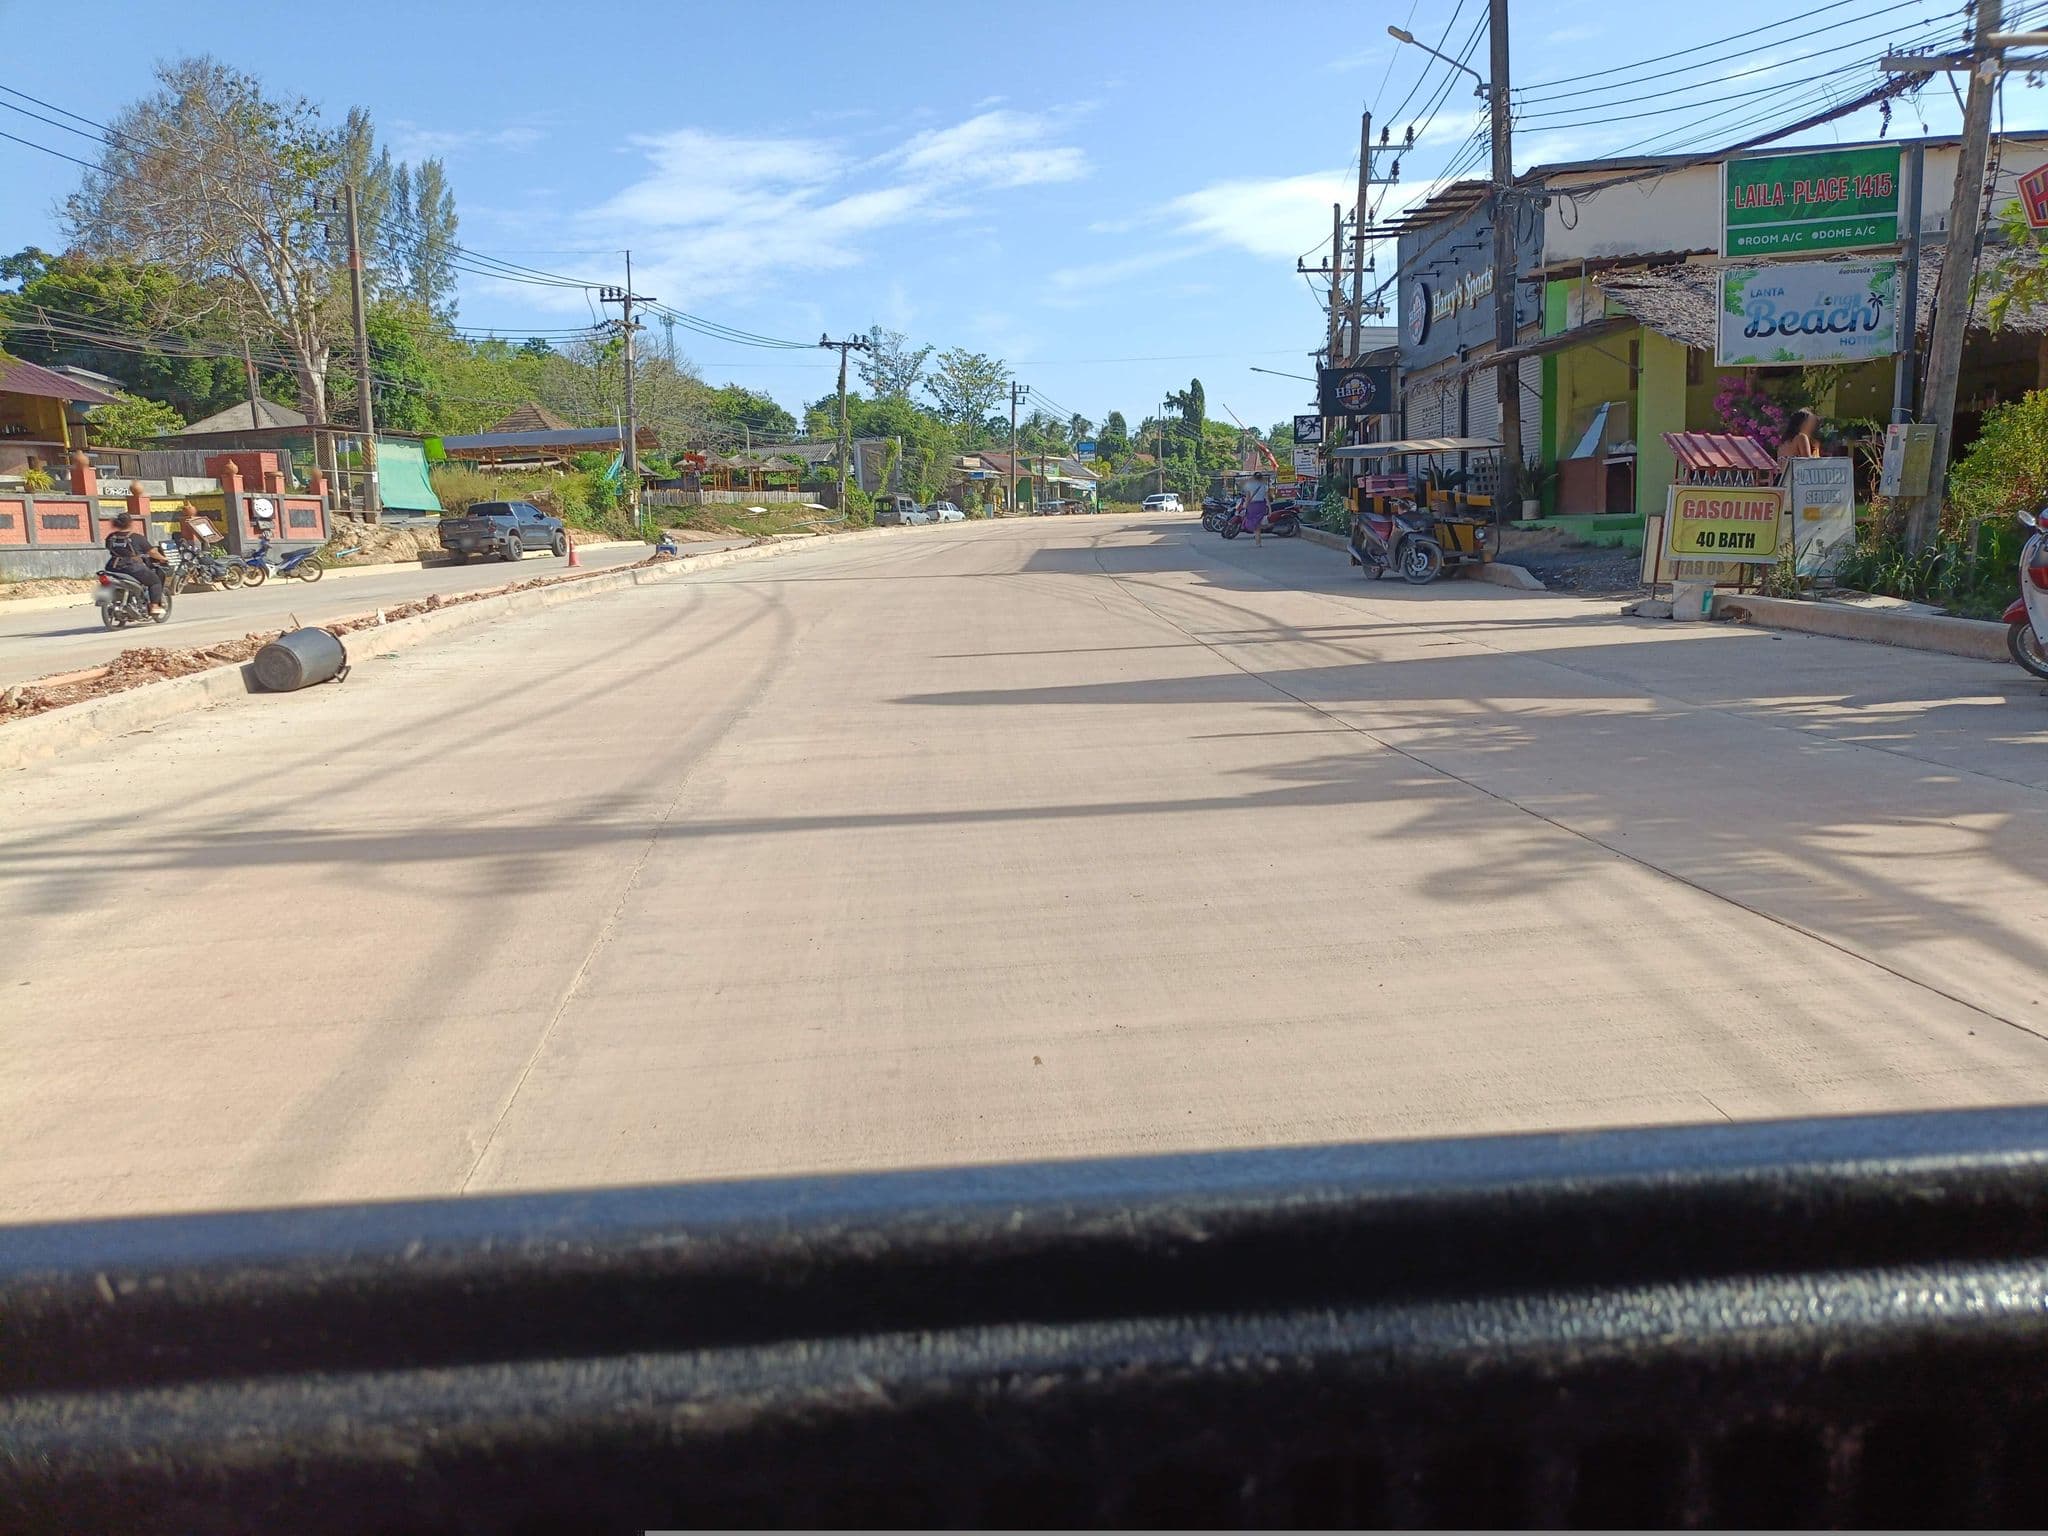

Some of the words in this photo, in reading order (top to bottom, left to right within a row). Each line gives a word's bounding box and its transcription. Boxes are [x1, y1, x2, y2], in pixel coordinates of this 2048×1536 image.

[1735, 182, 1784, 209] LAILA
[1794, 177, 1848, 204] PLACE
[1853, 173, 1892, 199] 1415
[1745, 234, 1779, 246] ROOM
[1782, 232, 1803, 243] A/C
[1818, 228, 1852, 240] DOME
[1854, 226, 1876, 237] A/C
[1432, 278, 1464, 323] Harry's
[1465, 264, 1495, 310] Sports
[1750, 287, 1785, 299] LANTA
[1744, 295, 1878, 338] Beach
[1335, 382, 1376, 400] Harry's
[1682, 499, 1774, 521] GASOLINE
[1696, 531, 1715, 548] 40
[1718, 532, 1755, 549] BATH
